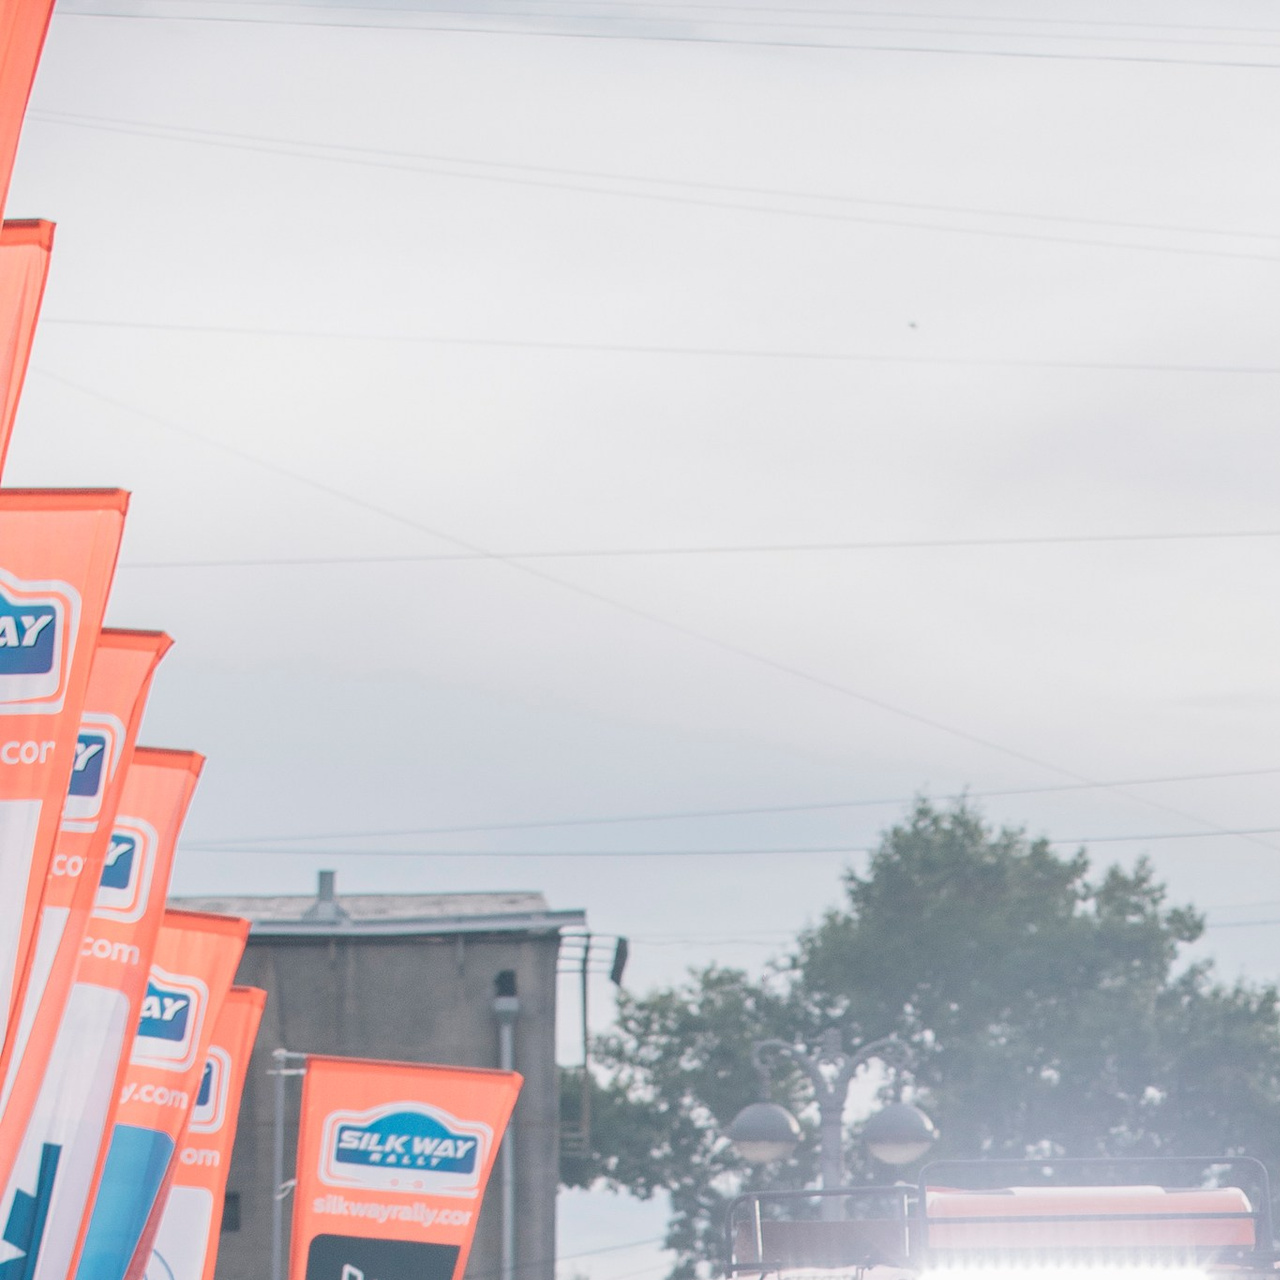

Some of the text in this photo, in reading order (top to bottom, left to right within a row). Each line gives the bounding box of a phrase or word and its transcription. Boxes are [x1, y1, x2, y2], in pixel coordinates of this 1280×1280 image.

[338, 1129, 477, 1160] SILK WAY
[369, 1153, 442, 1168] RALLY
